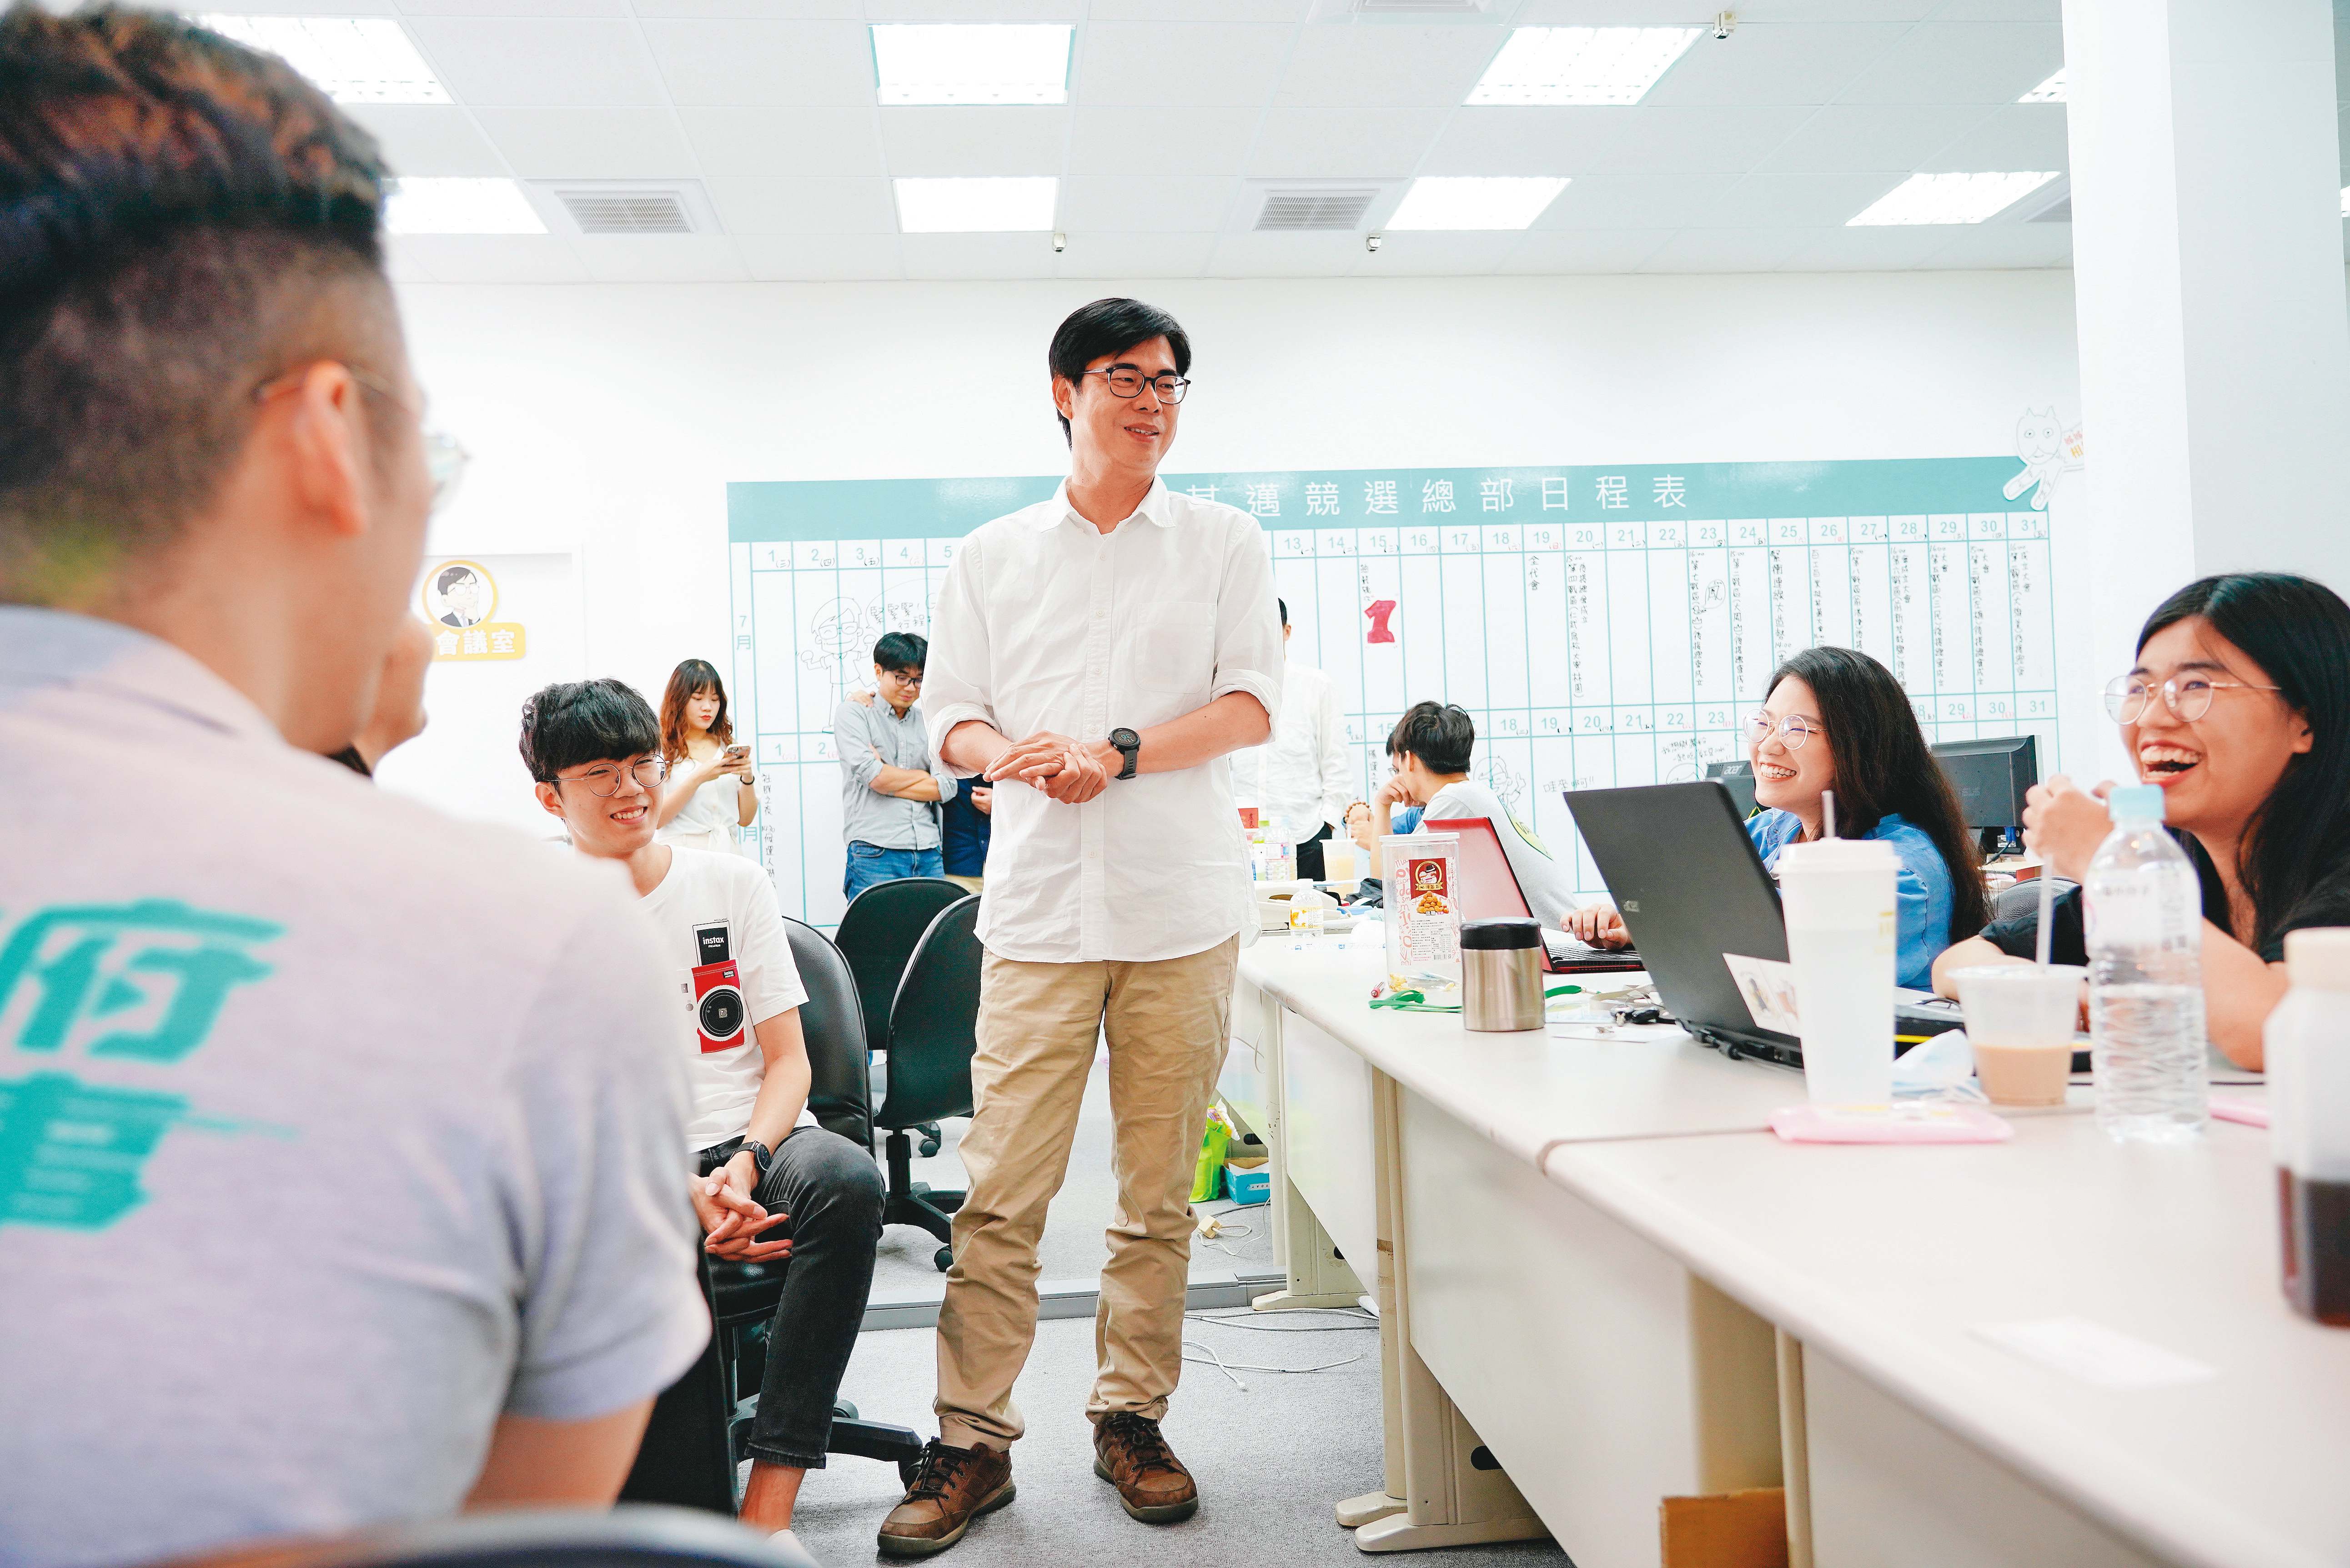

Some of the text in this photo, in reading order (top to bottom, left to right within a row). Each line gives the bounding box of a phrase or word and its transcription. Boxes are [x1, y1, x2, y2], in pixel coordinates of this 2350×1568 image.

[1821, 524, 1838, 537] 26
[1861, 523, 1877, 535] 27
[1901, 523, 1917, 534] 28
[1940, 522, 1957, 533] 29
[1981, 520, 1997, 532] 30
[2021, 519, 2037, 531] 31
[1534, 531, 1550, 543] 19
[1576, 530, 1593, 543] 20
[1618, 529, 1633, 542] 21
[1659, 528, 1676, 540] 22
[1700, 527, 1717, 539] 23
[1740, 526, 1757, 538] 24
[1781, 525, 1797, 538] 25
[1284, 537, 1301, 550] 13
[1328, 536, 1345, 548] 14
[1370, 535, 1386, 548] 15
[1411, 534, 1427, 546] 16
[1452, 533, 1468, 545] 17
[1493, 532, 1509, 544] 18
[768, 550, 774, 562] 1
[811, 549, 819, 561] 2
[856, 548, 864, 560] 3
[900, 547, 908, 558] 4
[944, 546, 952, 558] 5
[435, 628, 516, 656] 會議室
[1918, 705, 1925, 717] 8
[1948, 703, 1965, 715] 29
[1989, 702, 2005, 714] 30
[2030, 700, 2045, 713] 31
[1541, 717, 1559, 730] 19
[1584, 716, 1601, 728] 20
[1626, 714, 1642, 728] 21
[1667, 713, 1683, 725] 22
[1708, 711, 1725, 724] 23
[1346, 724, 1352, 736] 4
[1378, 723, 1395, 736] 15
[1501, 718, 1517, 731] 18
[775, 744, 782, 756] 1
[818, 742, 826, 754] 2
[1723, 764, 1743, 775] acer
[703, 937, 724, 945] instax
